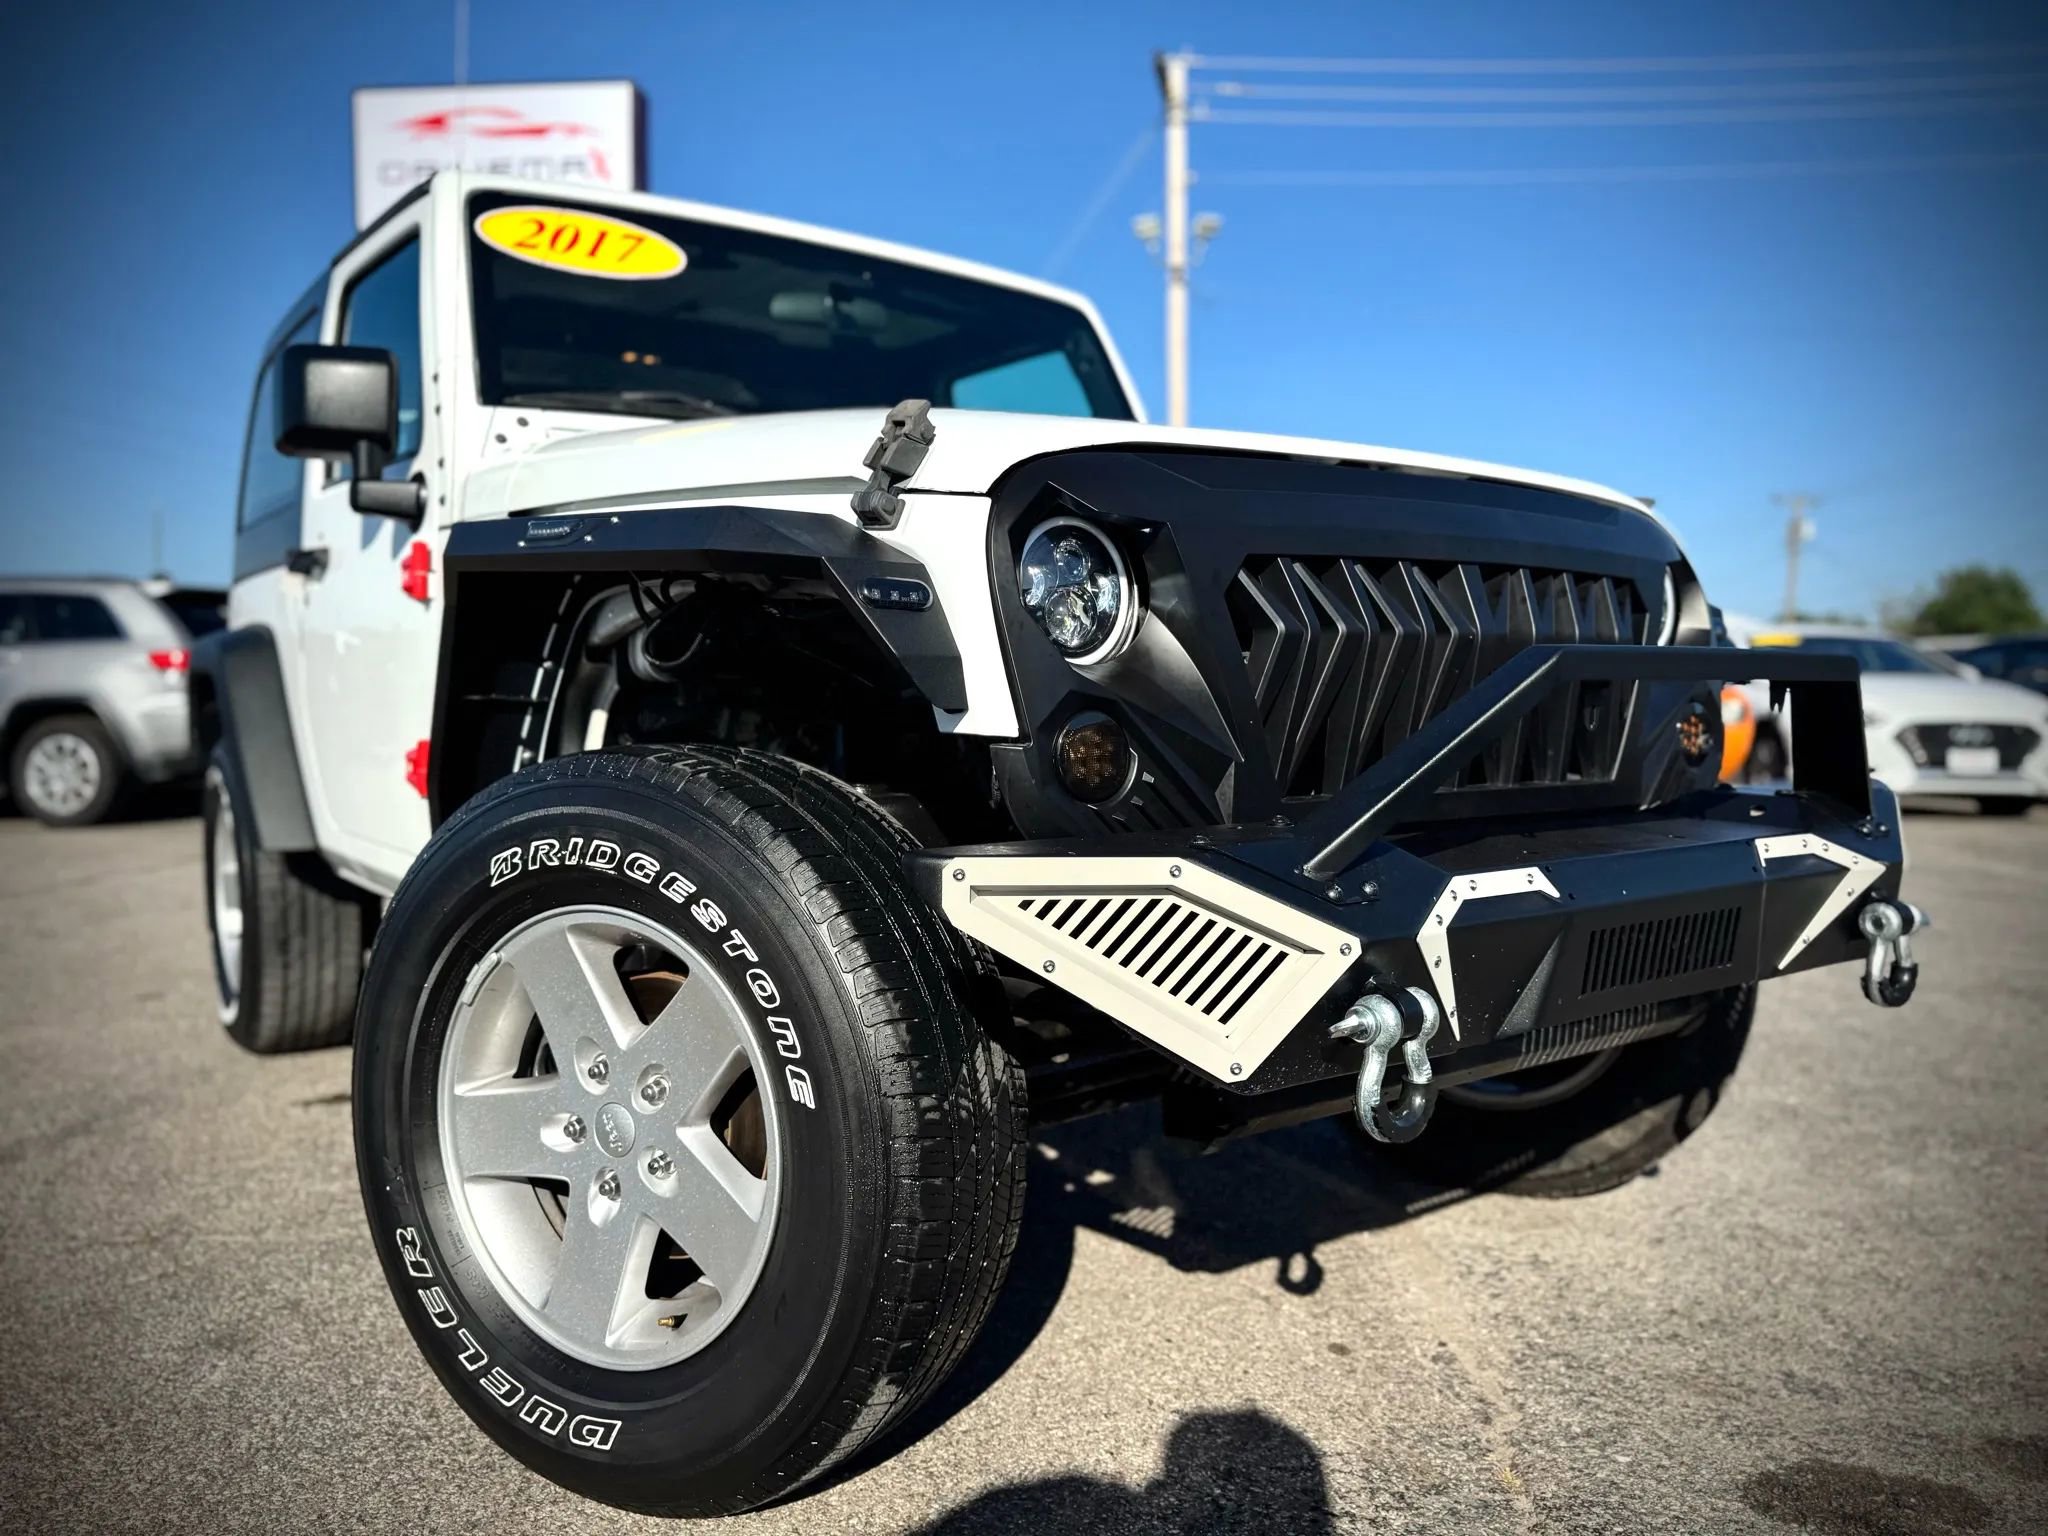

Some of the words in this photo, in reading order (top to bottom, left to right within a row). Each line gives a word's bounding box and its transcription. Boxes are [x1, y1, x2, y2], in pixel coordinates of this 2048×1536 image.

[512, 217, 646, 262] 2017
[490, 837, 815, 1110] BRIDGESTONE
[396, 1227, 622, 1450] DUELER
